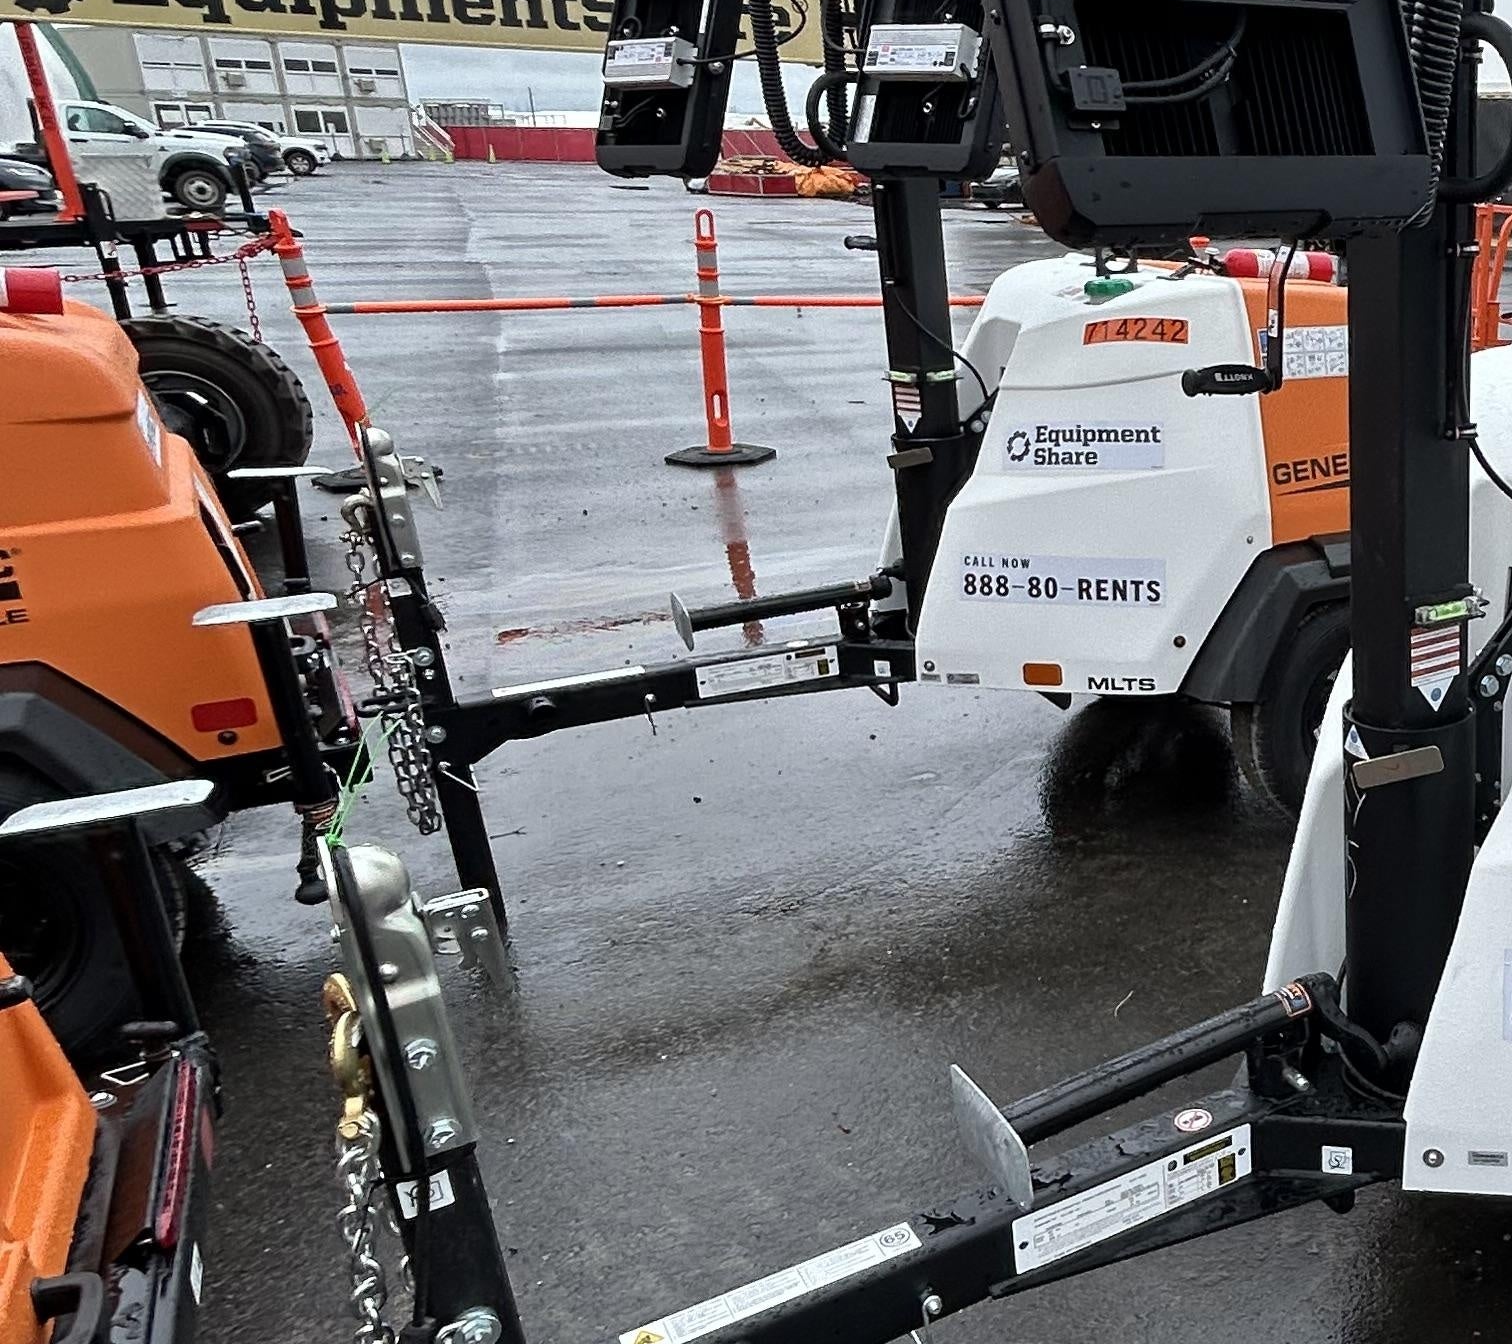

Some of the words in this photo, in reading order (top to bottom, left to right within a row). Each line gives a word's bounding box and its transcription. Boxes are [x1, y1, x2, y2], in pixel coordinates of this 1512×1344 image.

[1087, 318, 1185, 343] 714242
[1034, 425, 1161, 446] Equipment
[1033, 447, 1098, 466] Share
[1273, 453, 1349, 485] GENE
[964, 556, 994, 568] CALL
[1001, 557, 1030, 569] NOW
[963, 573, 1161, 602] 888-80-RENTS
[1087, 677, 1156, 691] MLTS
[882, 1230, 907, 1246] 65
